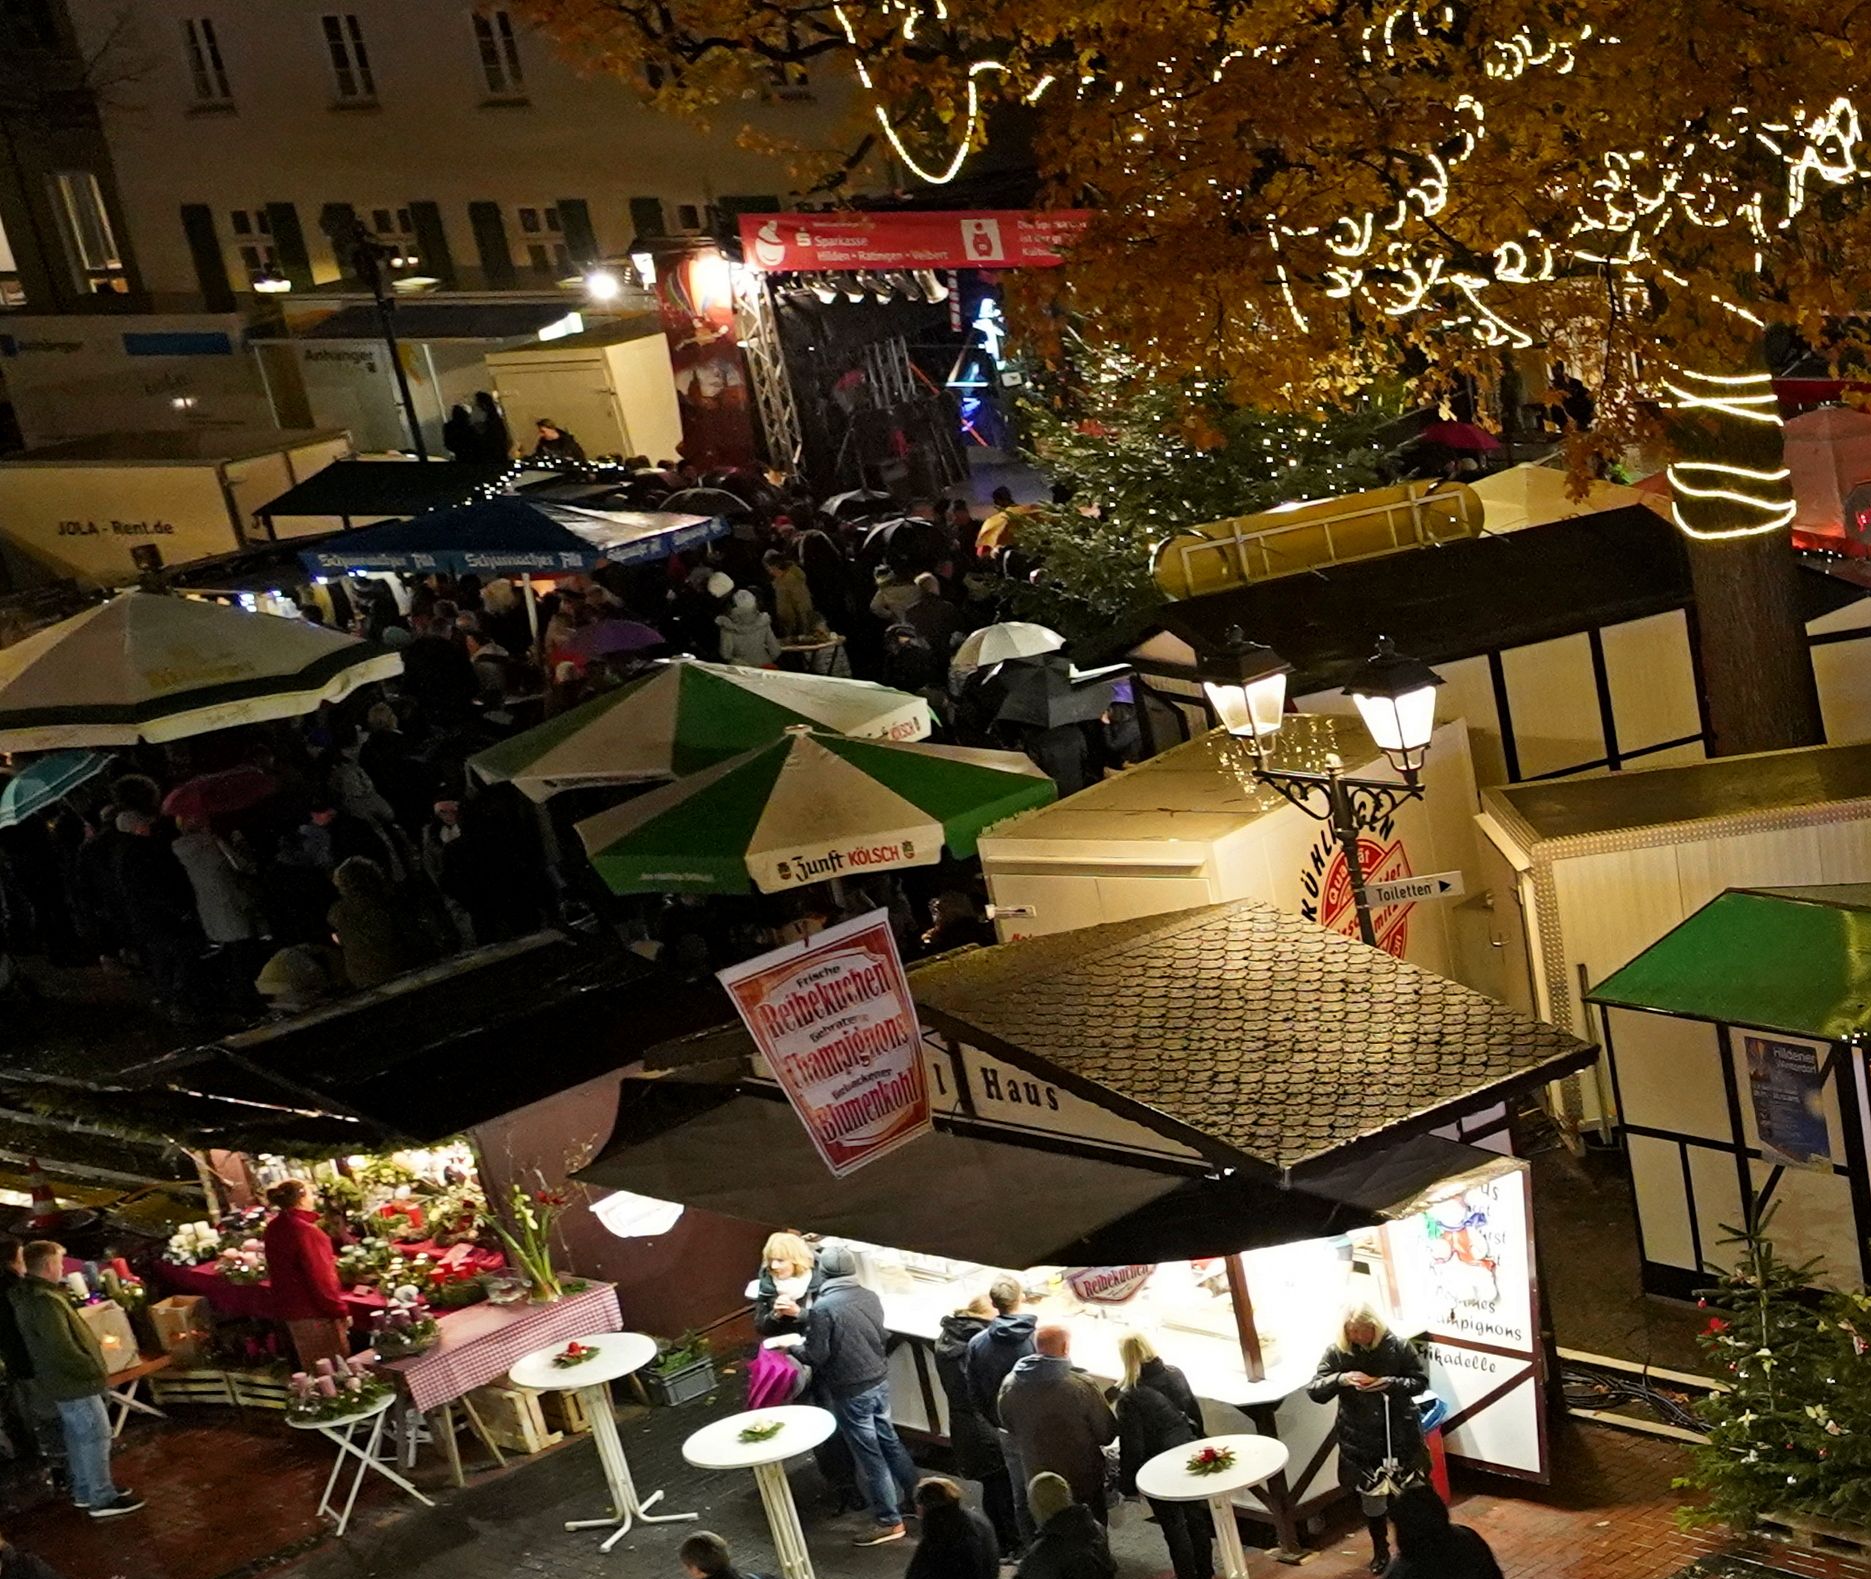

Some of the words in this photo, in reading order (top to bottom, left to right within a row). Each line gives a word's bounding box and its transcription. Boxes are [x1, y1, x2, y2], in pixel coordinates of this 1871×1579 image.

[814, 235, 869, 248] Sparkasse
[57, 520, 99, 537] JOLA
[110, 520, 175, 537] Rent.de
[464, 553, 554, 569] Schumacher
[848, 845, 900, 867] KÖLSCH
[1376, 883, 1432, 902] Toiletten
[796, 963, 841, 989] Frische
[758, 961, 892, 1039] Reibekuchen
[980, 1066, 1059, 1112] Haus
[815, 1069, 919, 1144] Blumenkohl
